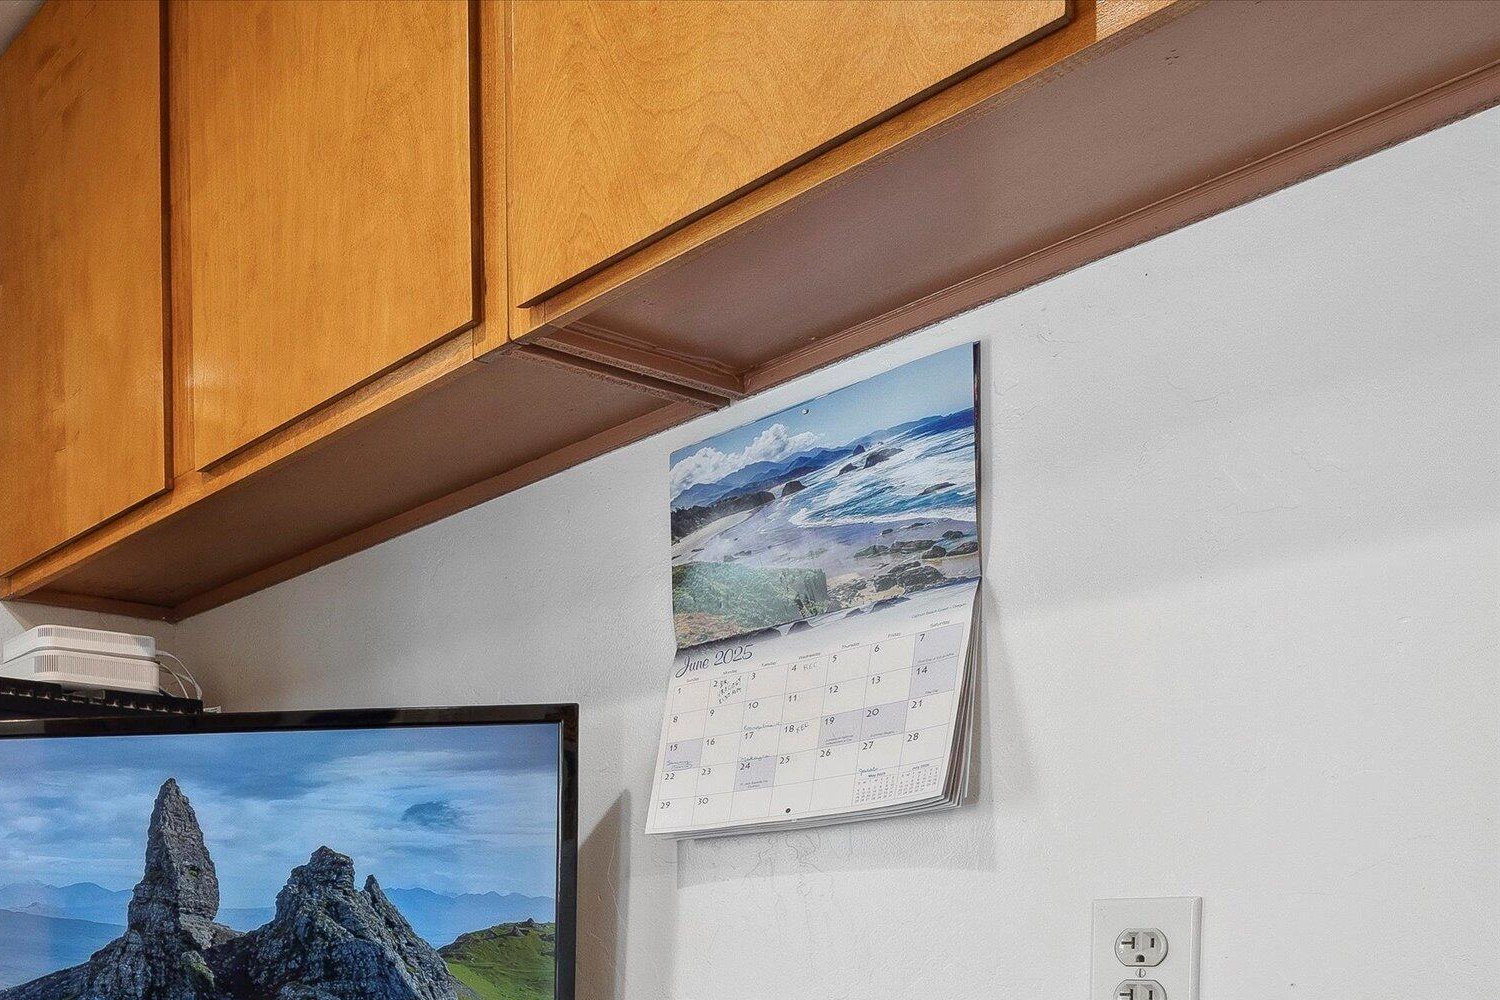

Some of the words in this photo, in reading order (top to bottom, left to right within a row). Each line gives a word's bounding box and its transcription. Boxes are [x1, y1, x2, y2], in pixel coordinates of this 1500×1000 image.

[920, 634, 926, 642] 7
[675, 655, 710, 679] June
[714, 644, 754, 666] 2025
[832, 655, 837, 663] 5
[916, 666, 928, 675] 14
[872, 676, 881, 684] 13
[829, 685, 839, 694] 12
[788, 694, 797, 702] 11
[748, 701, 759, 709] 10
[911, 700, 923, 709] 21
[709, 709, 715, 717] 9
[866, 708, 880, 717] 20
[673, 715, 679, 723] 8
[824, 716, 835, 725] 19
[784, 725, 795, 733] 18
[744, 732, 754, 740] 17
[906, 733, 919, 742] 28
[706, 738, 715, 746] 16
[862, 741, 874, 750] 27
[820, 749, 831, 757] 26
[779, 756, 790, 764] 25
[740, 762, 751, 771] 24
[701, 768, 712, 776] 23
[664, 773, 675, 781] 22
[697, 797, 709, 806] 30
